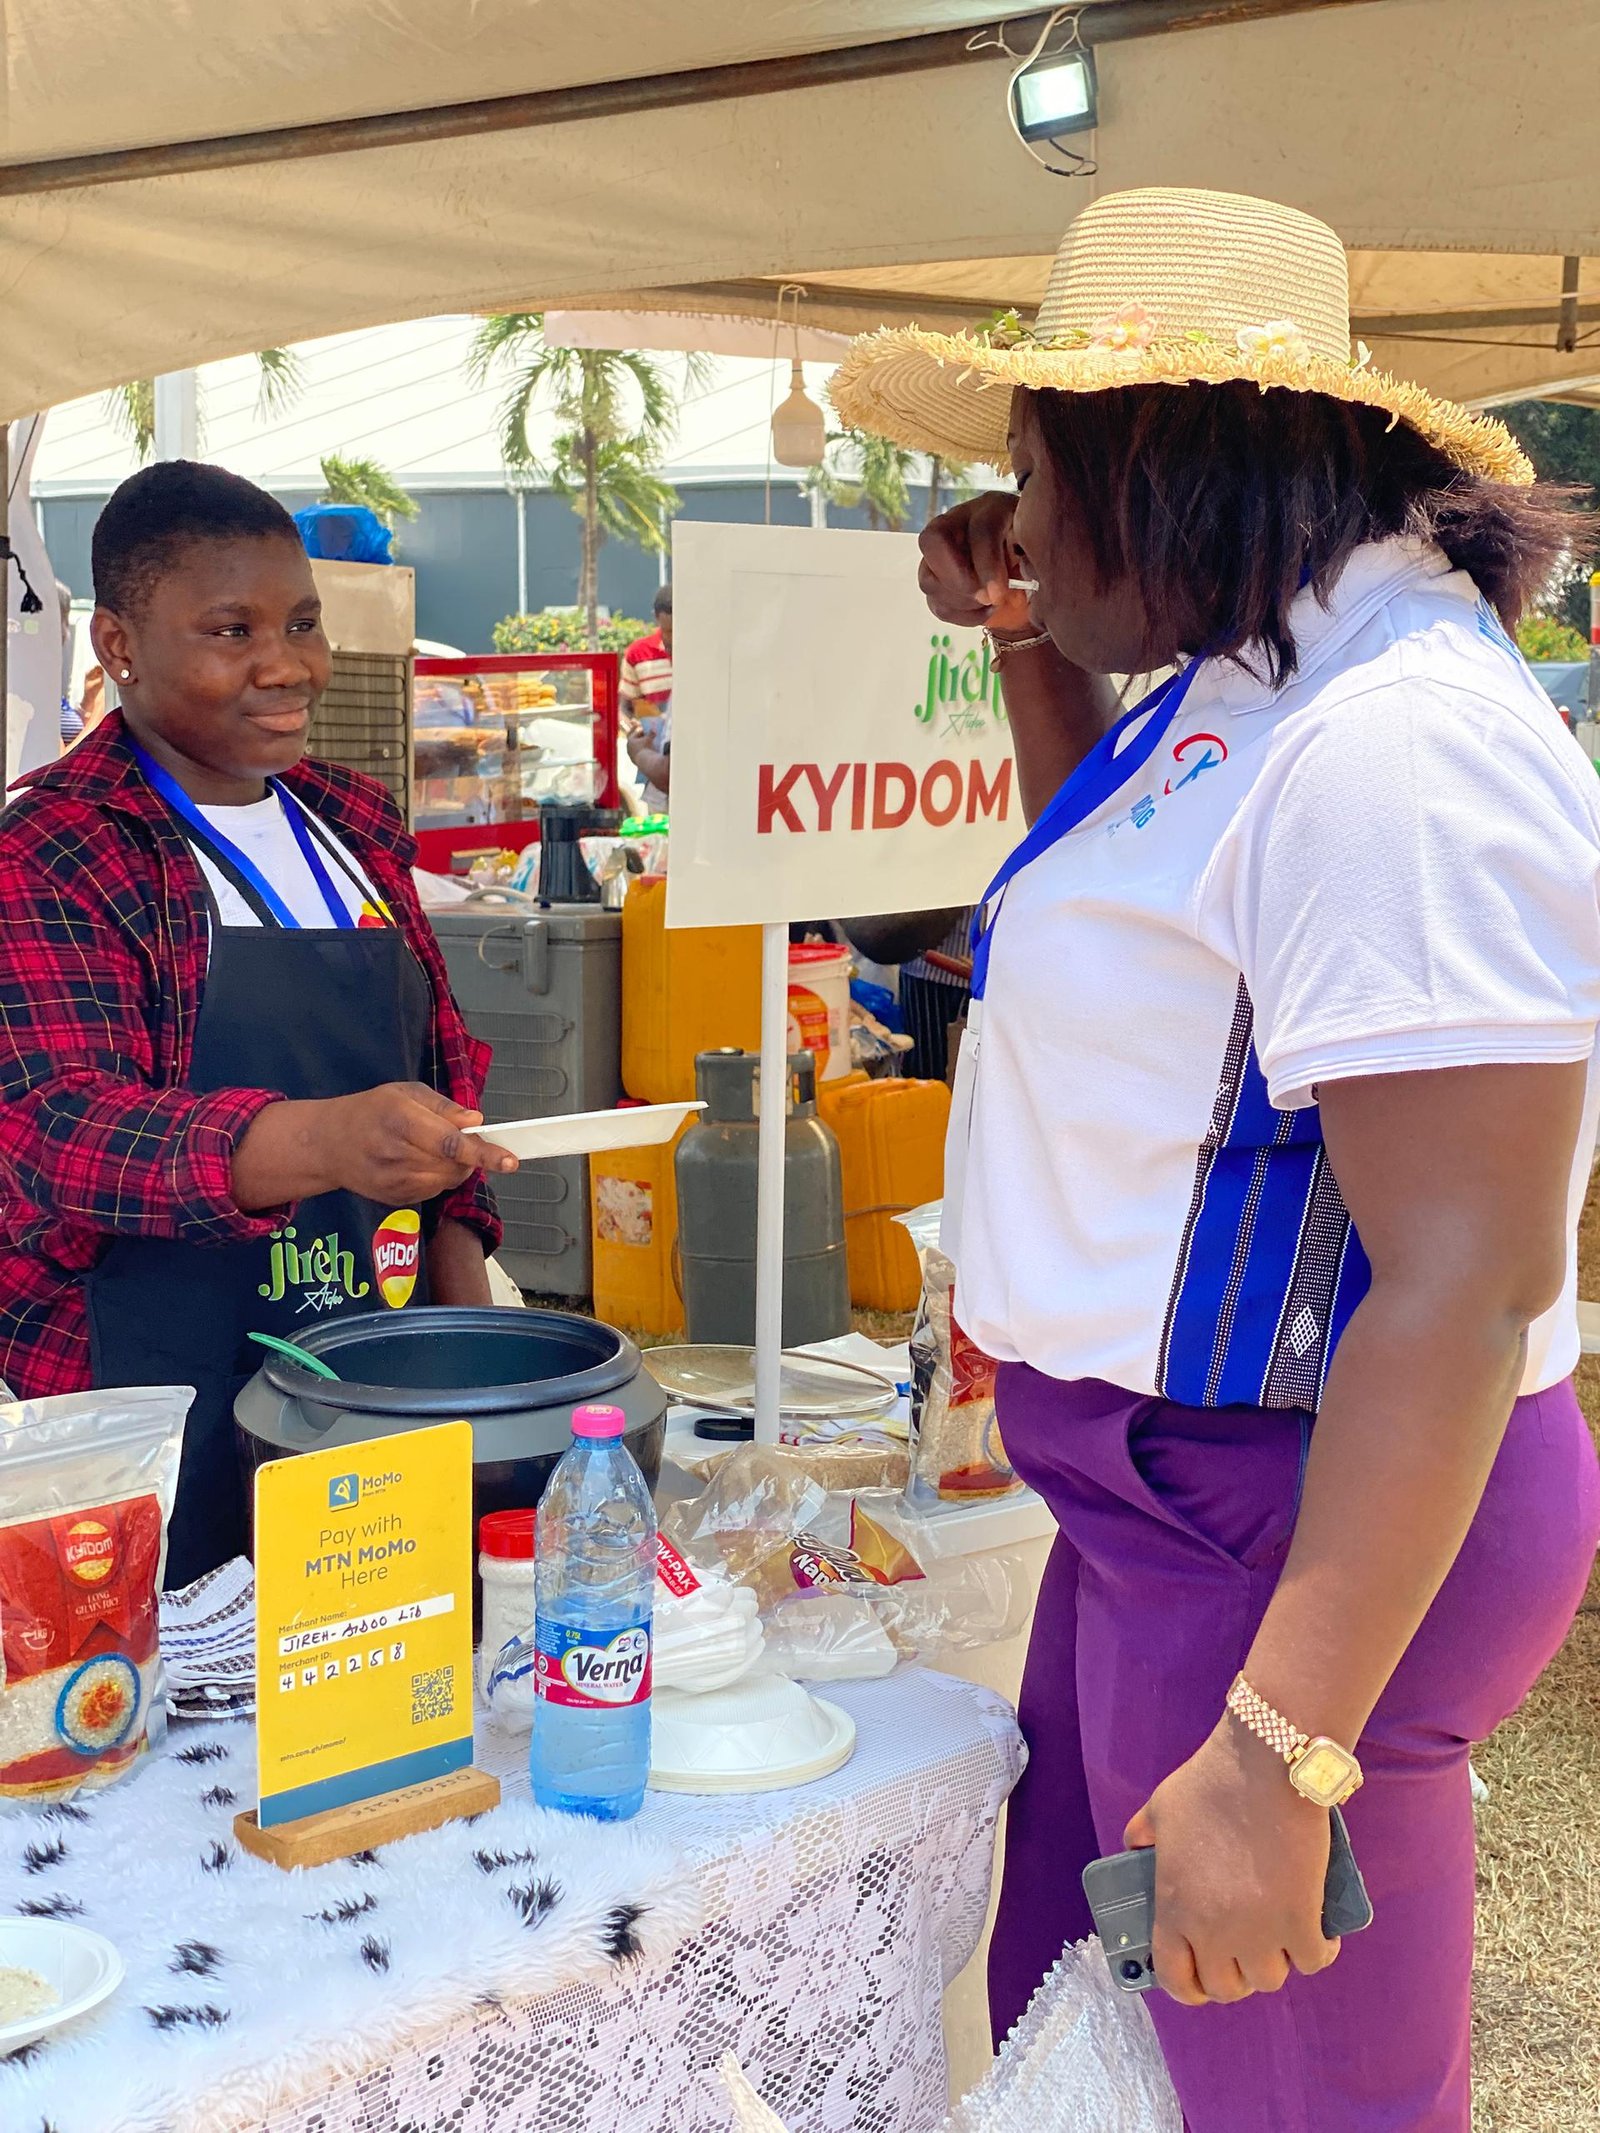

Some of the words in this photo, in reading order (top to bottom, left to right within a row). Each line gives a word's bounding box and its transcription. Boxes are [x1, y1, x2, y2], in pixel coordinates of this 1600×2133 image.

[757, 758, 1012, 834] KYIDOM
[258, 1226, 370, 1301] jireh
[363, 1472, 402, 1490] MoMo
[320, 1528, 356, 1548] Pay
[362, 1514, 402, 1537] with
[305, 1550, 351, 1578] MTN
[358, 1538, 417, 1564] MoMo
[341, 1565, 388, 1590] Here
[278, 1616, 319, 1634] Merchant
[320, 1610, 347, 1623] Name:
[279, 1654, 319, 1672] Merchant
[320, 1651, 332, 1661] ID:
[572, 1651, 643, 1684] Verna
[604, 1681, 624, 1689] WATER
